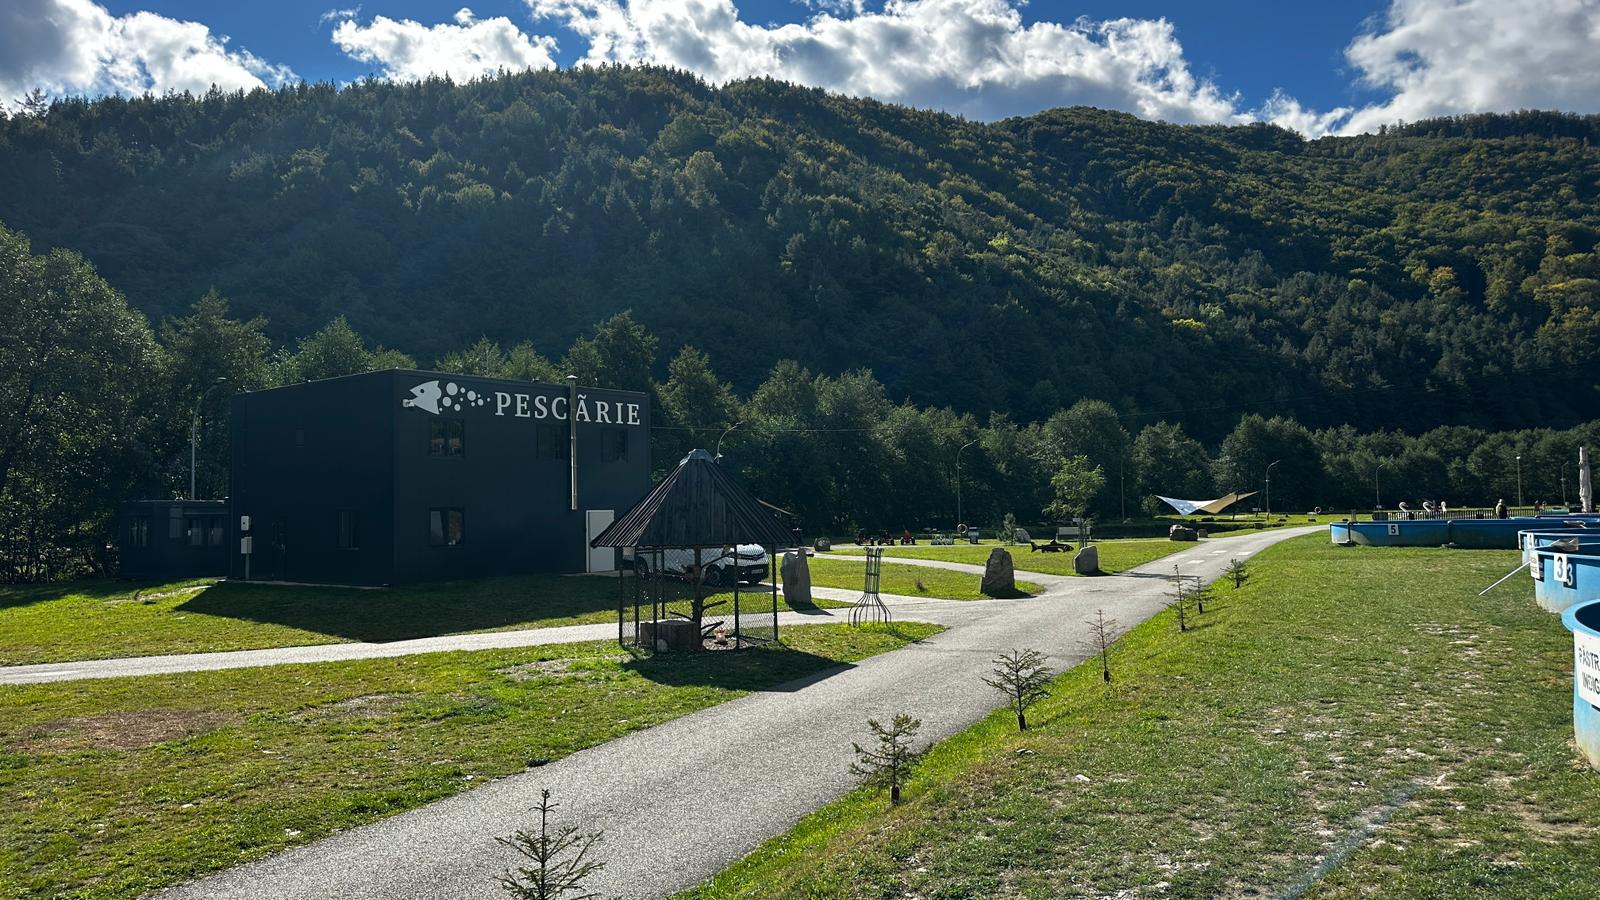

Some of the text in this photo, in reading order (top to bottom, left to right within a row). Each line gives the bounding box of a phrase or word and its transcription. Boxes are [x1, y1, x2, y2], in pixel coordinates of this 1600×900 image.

[1390, 525, 1396, 534] 5
[1556, 556, 1564, 579] 3
[1566, 563, 1573, 586] 3
